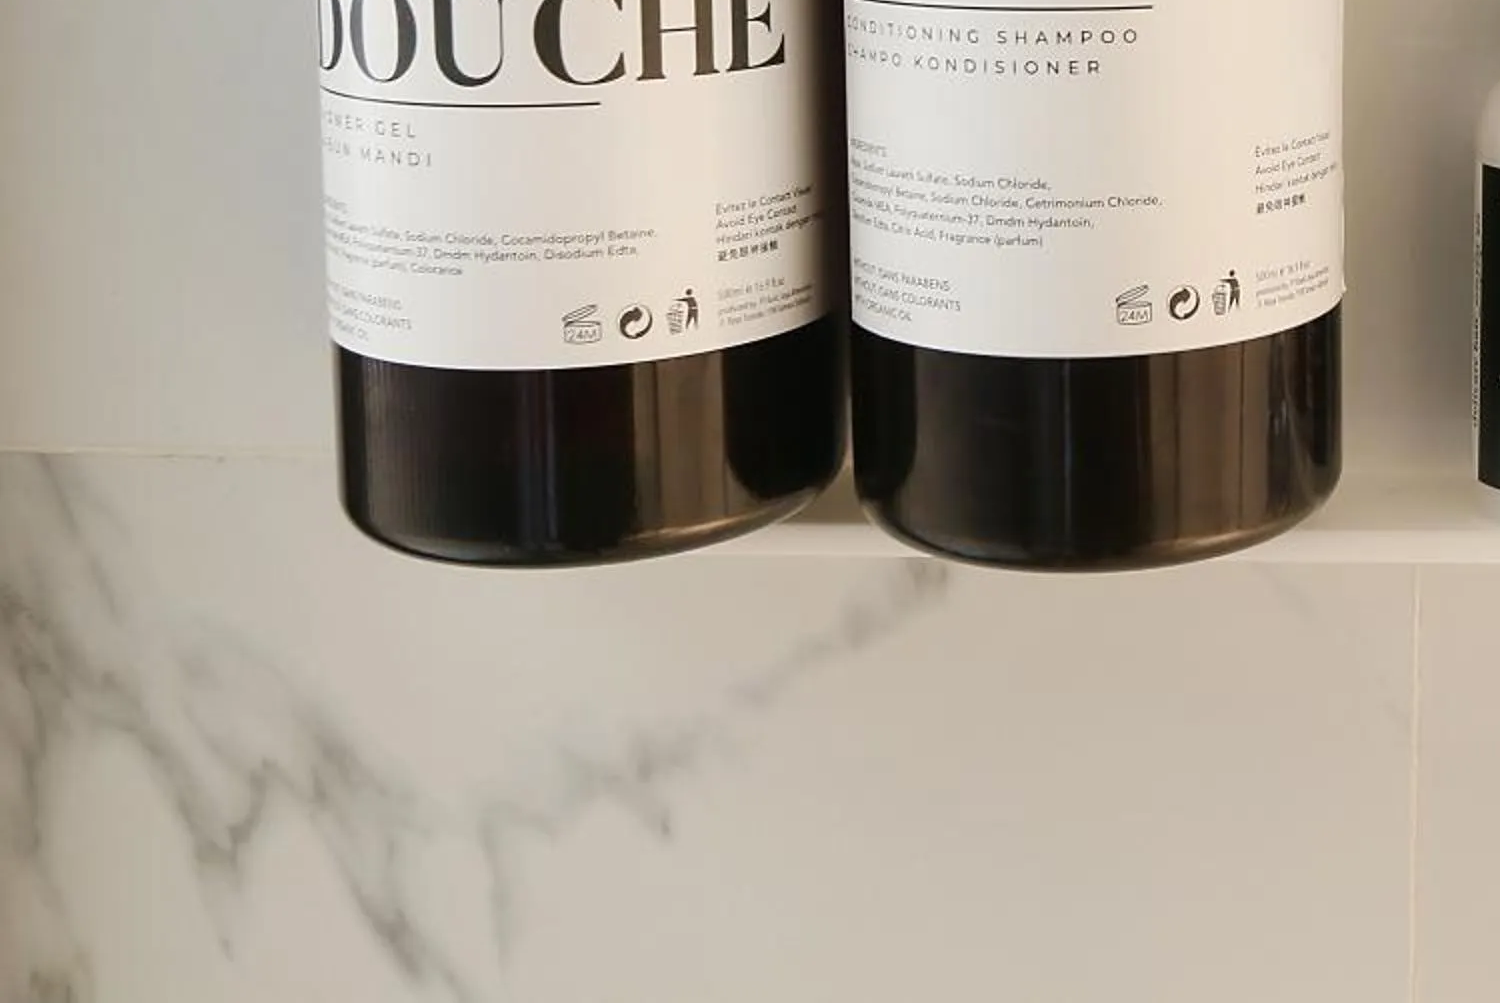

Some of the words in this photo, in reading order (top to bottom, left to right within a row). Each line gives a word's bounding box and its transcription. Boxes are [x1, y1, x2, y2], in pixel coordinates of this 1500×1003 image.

[996, 29, 1138, 45] SHAMPOO
[914, 56, 1101, 75] KONDISIONER
[375, 119, 417, 139] GEL
[361, 147, 432, 168] MANDI
[954, 175, 995, 188] Sodium
[997, 177, 1051, 191] Chloride,
[971, 194, 1022, 209] Chloride,
[1025, 196, 1105, 209] Cetrimonium
[1107, 196, 1164, 208] Chloride,
[716, 218, 745, 229] Avoid
[748, 213, 764, 225] Eye
[1028, 216, 1095, 230] Hydantoin,
[939, 229, 991, 245] Fragrance
[994, 234, 1044, 249] (parfum)
[1121, 310, 1149, 322] 24M
